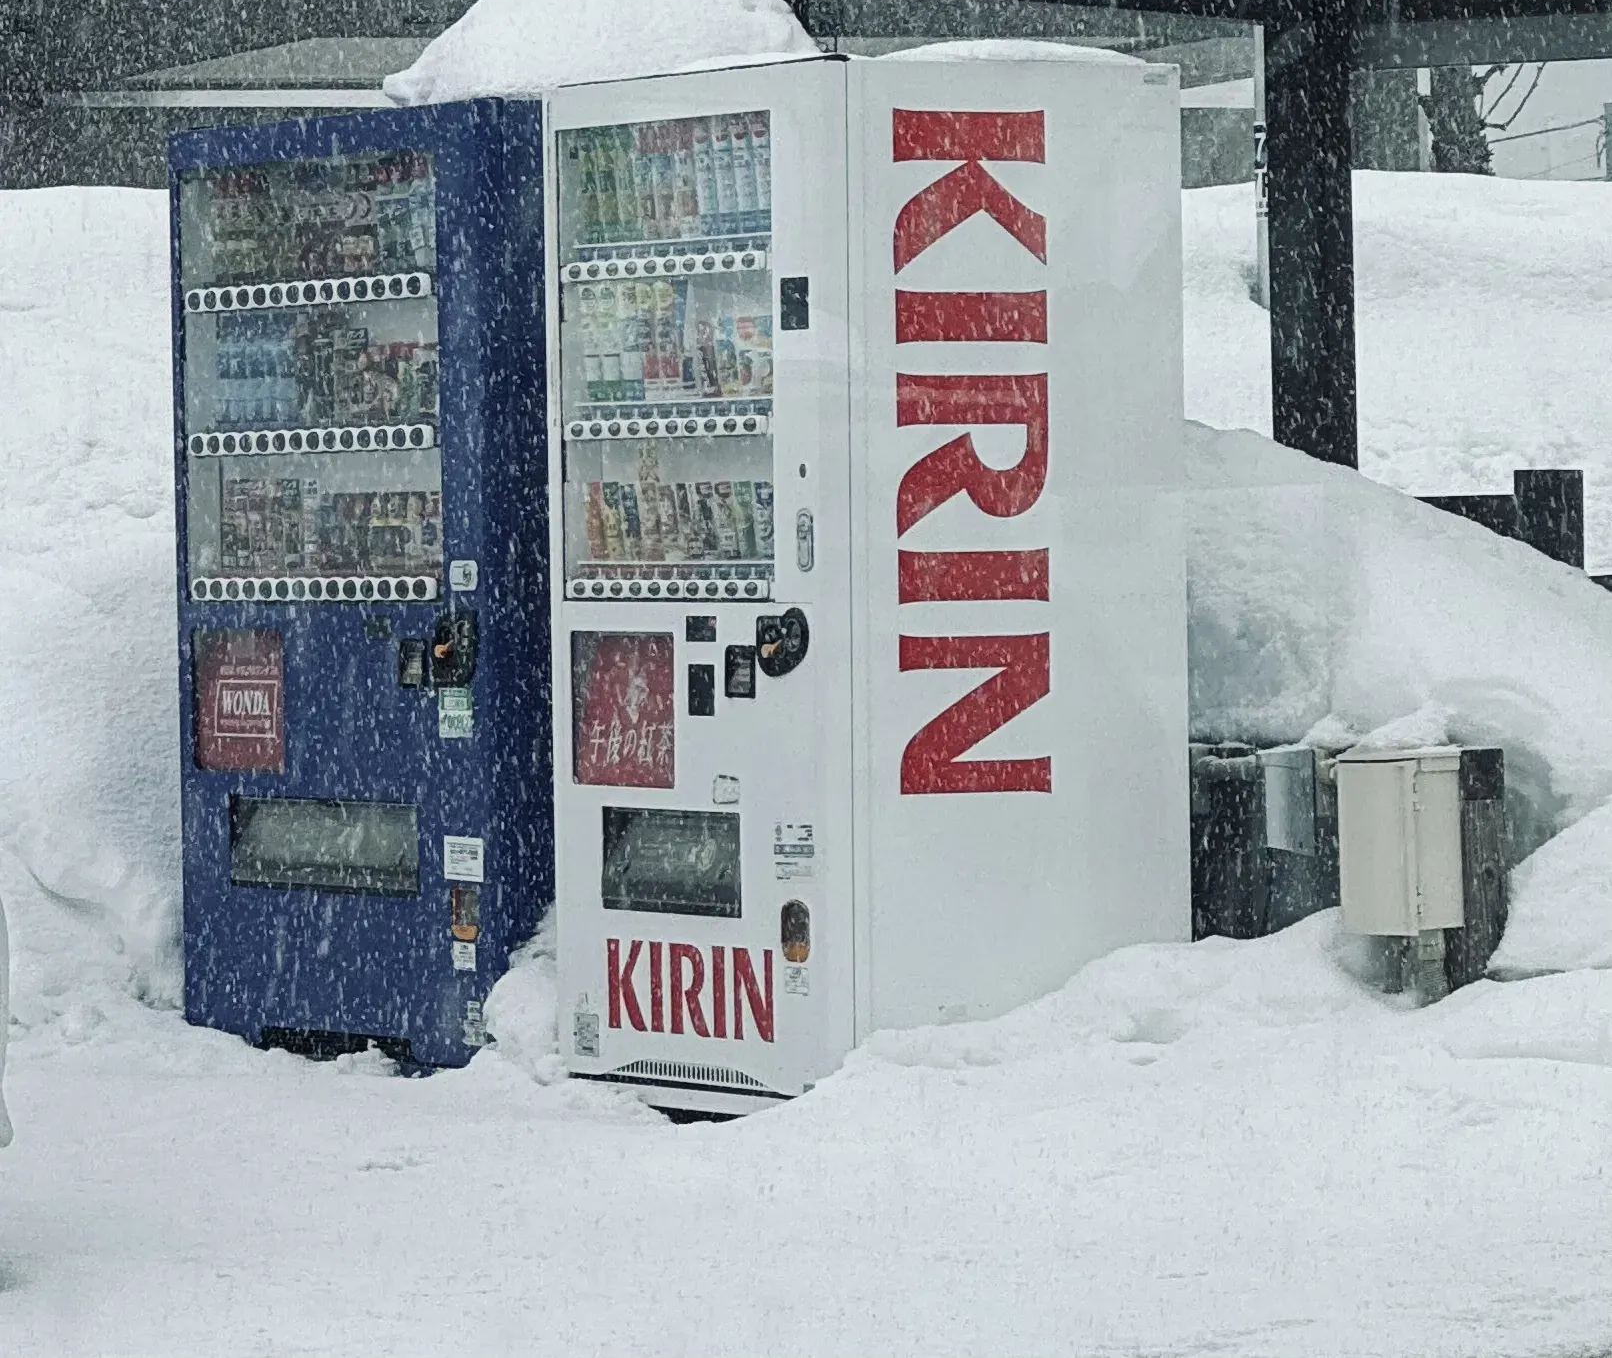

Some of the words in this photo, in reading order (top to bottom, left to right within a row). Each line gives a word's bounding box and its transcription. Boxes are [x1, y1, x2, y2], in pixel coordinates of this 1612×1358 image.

[893, 108, 1051, 794] KIRIN
[222, 690, 272, 716] WONDA
[590, 719, 674, 767] 午後の紅茶
[606, 938, 773, 1042] KIRIN
